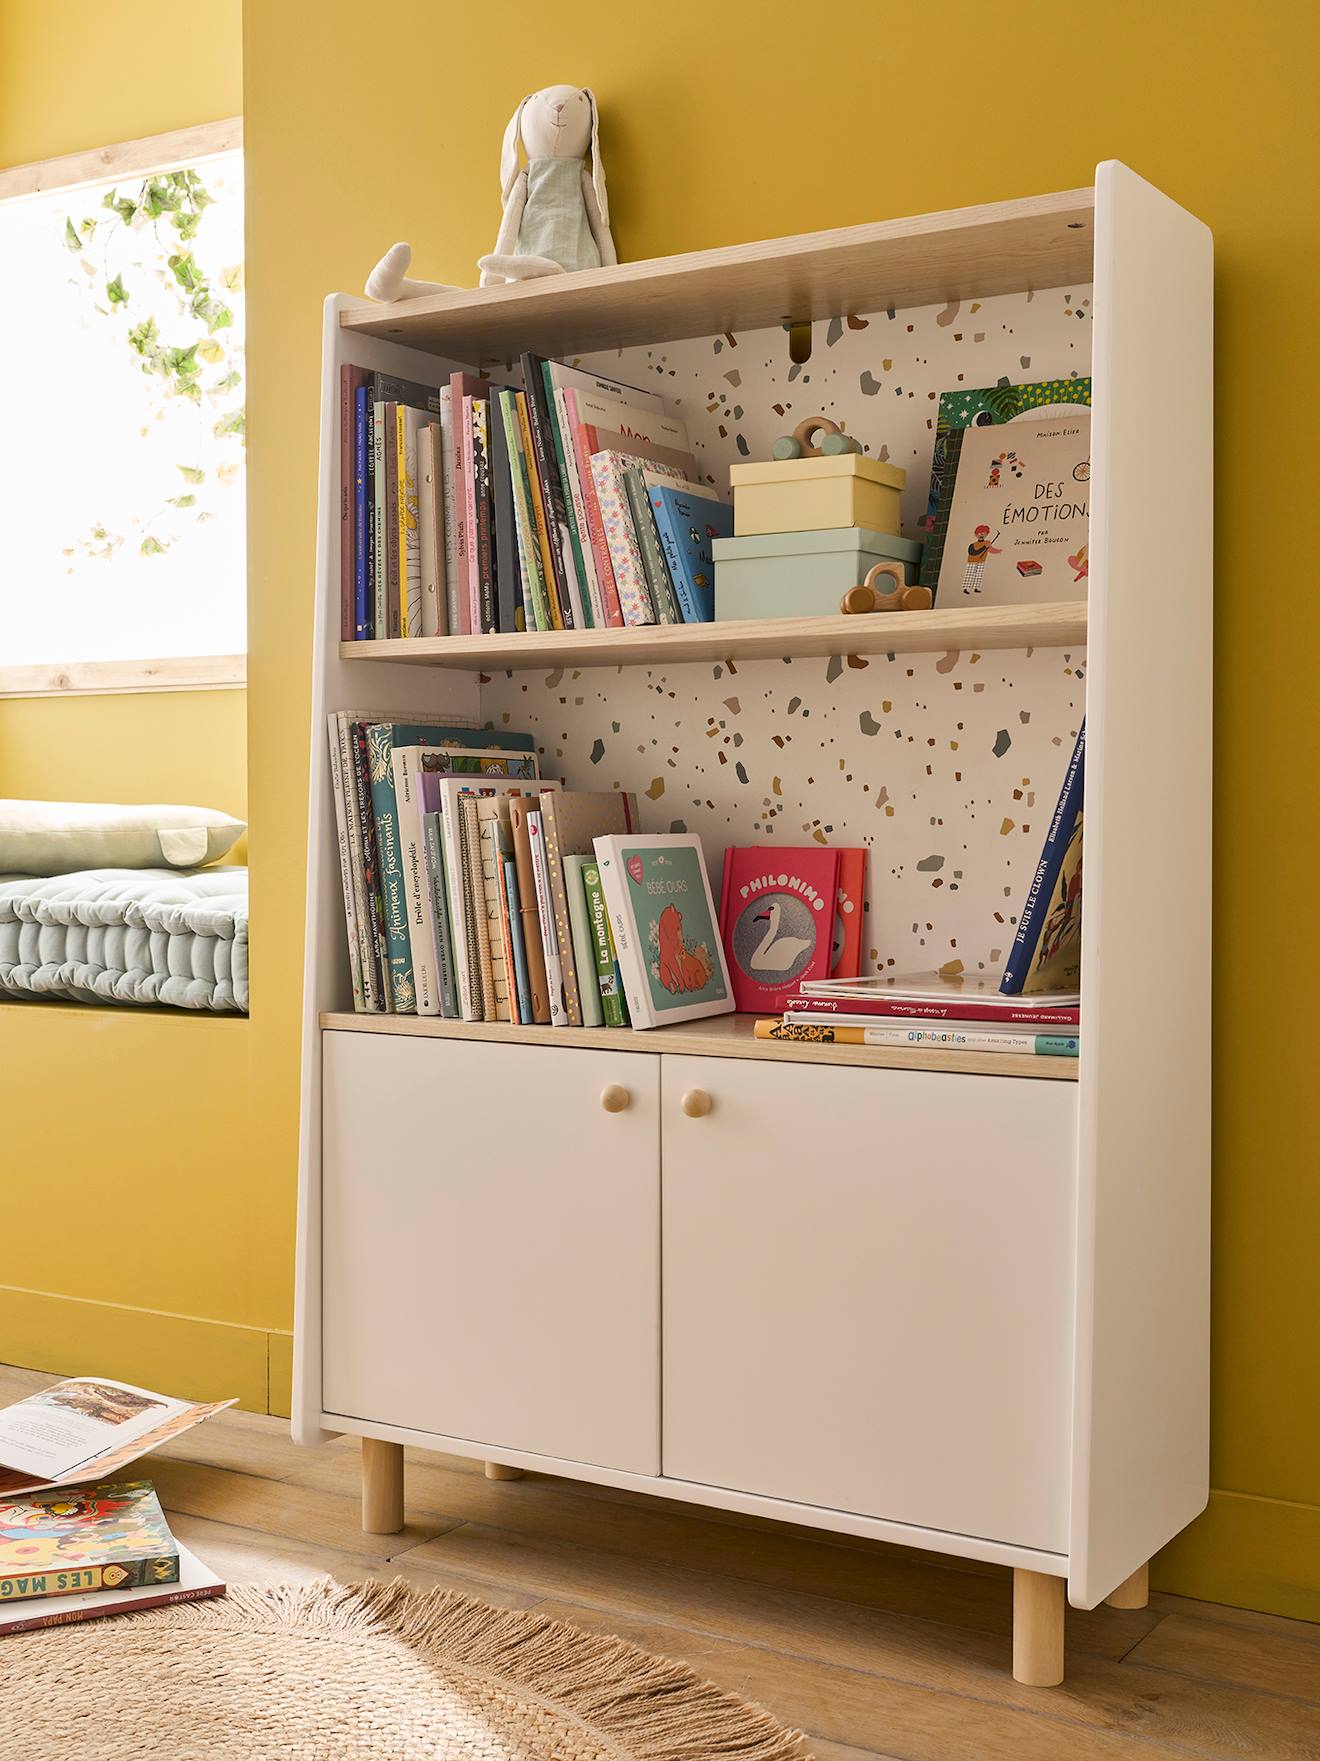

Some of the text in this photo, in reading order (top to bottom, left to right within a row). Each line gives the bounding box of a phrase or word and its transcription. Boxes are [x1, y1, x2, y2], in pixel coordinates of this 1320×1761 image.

[1034, 482, 1065, 499] DES
[479, 501, 488, 541] printemps
[574, 493, 587, 544] Petite pousse
[596, 528, 613, 576] CONTRAIRES
[341, 756, 349, 768] DE
[355, 766, 362, 777] DE
[357, 778, 365, 809] TRÉSORS
[1048, 815, 1061, 842] Elisabeth
[1057, 790, 1069, 814] Helland
[1064, 770, 1076, 791] Larsen
[1073, 740, 1086, 762] Marine
[345, 800, 353, 831] MAISON
[362, 826, 368, 834] ET
[349, 833, 355, 844] LA
[381, 813, 401, 877] fascinants
[409, 842, 423, 924] Drôle d'encyclopédie
[667, 879, 688, 894] OURS
[740, 874, 825, 911] PHILONIMO
[369, 893, 379, 937] HAWTHORNE
[389, 881, 408, 940] Animaux
[1016, 860, 1048, 943] JE SUIS LE CLOWN
[597, 892, 609, 964] La montagne
[616, 914, 625, 933] OURS
[57, 1571, 93, 1589] LES
[42, 1611, 85, 1626] MON PAPA
